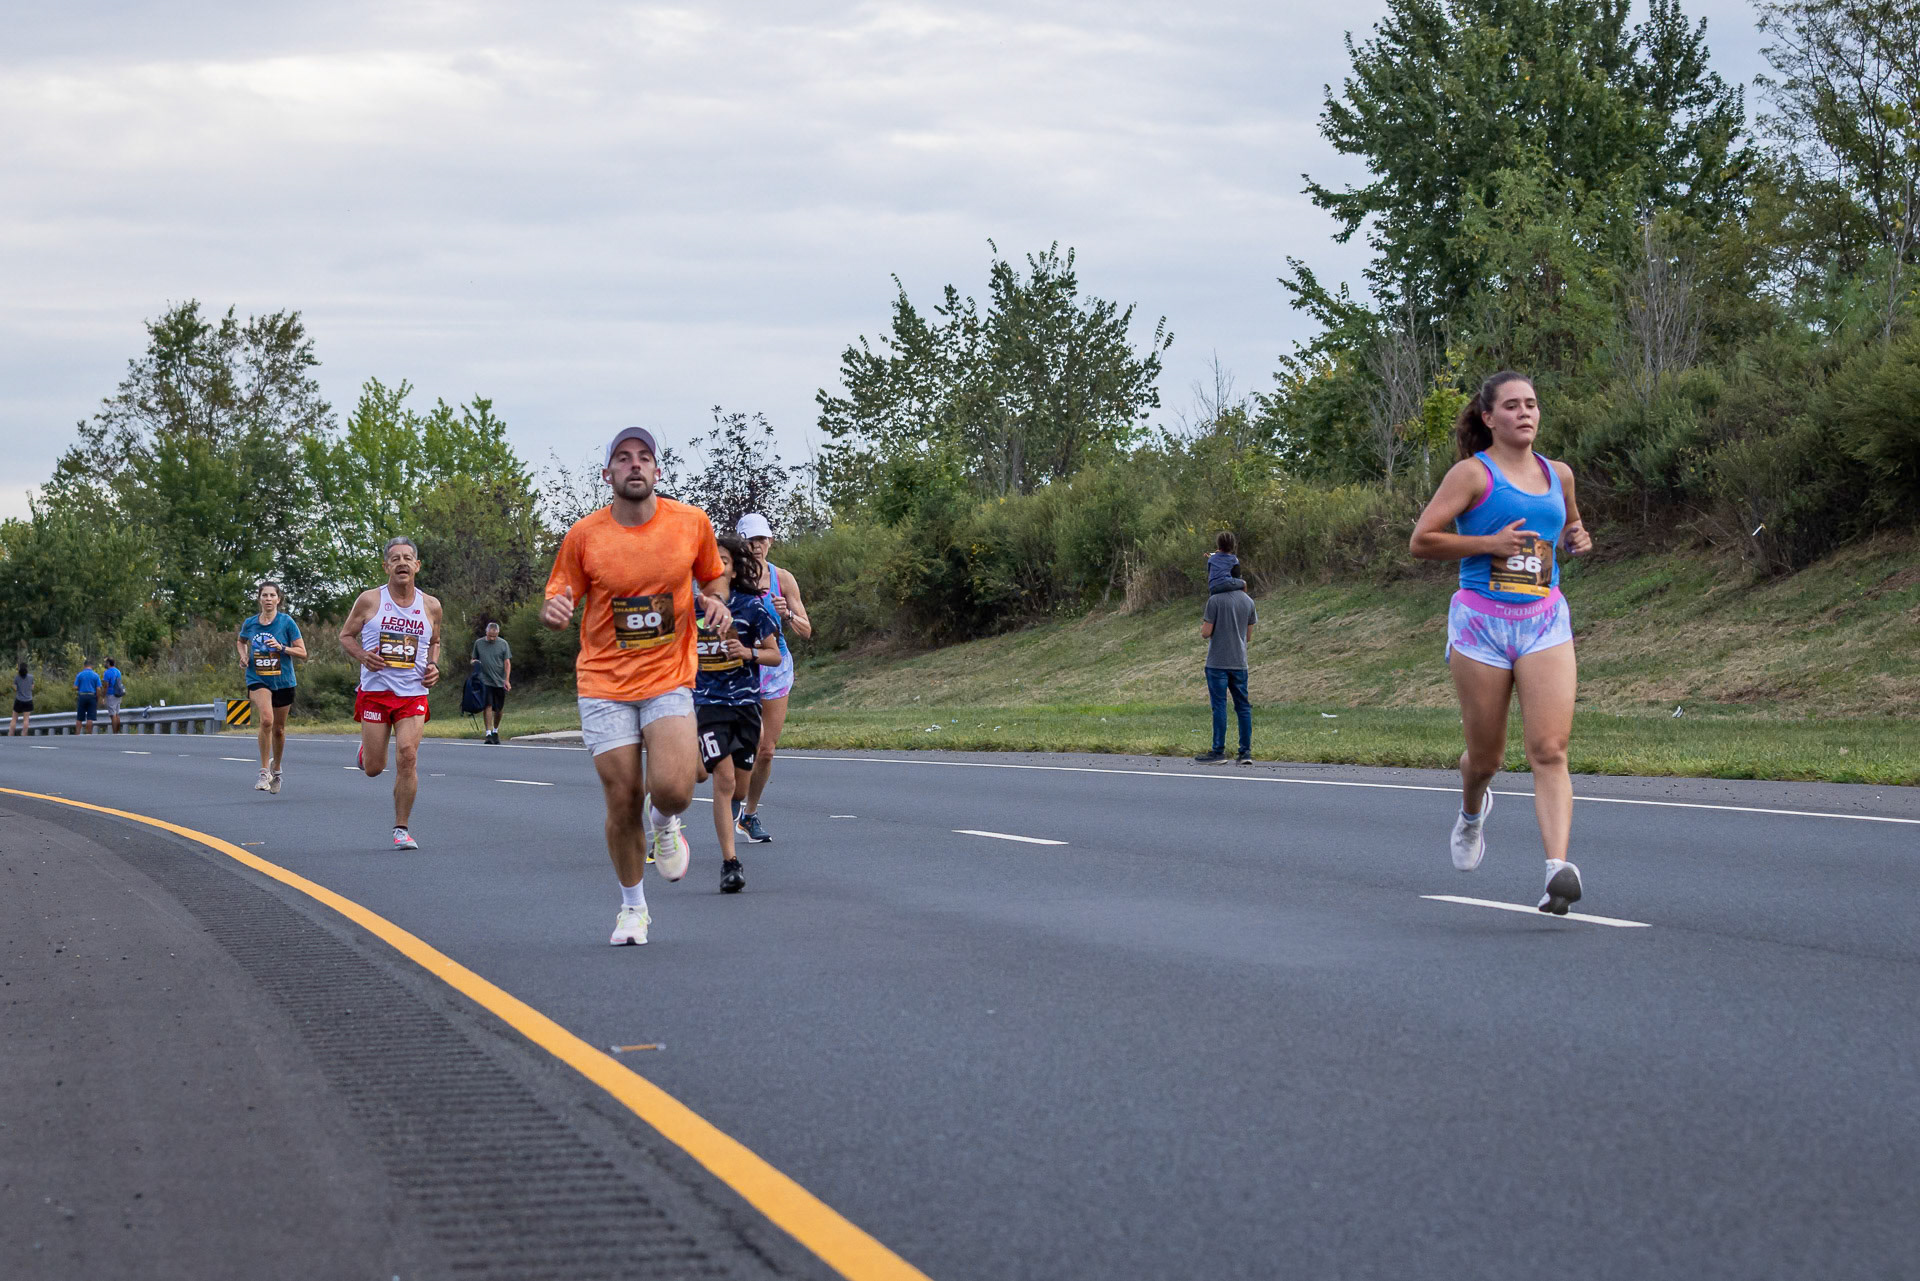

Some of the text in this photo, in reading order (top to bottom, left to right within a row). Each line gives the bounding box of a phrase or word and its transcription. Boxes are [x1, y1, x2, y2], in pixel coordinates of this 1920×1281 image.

[1506, 555, 1542, 573] 56
[381, 616, 425, 631] LEONIA
[627, 612, 662, 629] 80
[380, 625, 424, 636] TRACK CLUB
[381, 643, 415, 656] 243
[256, 659, 278, 667] 287
[364, 710, 381, 721] LEONIA
